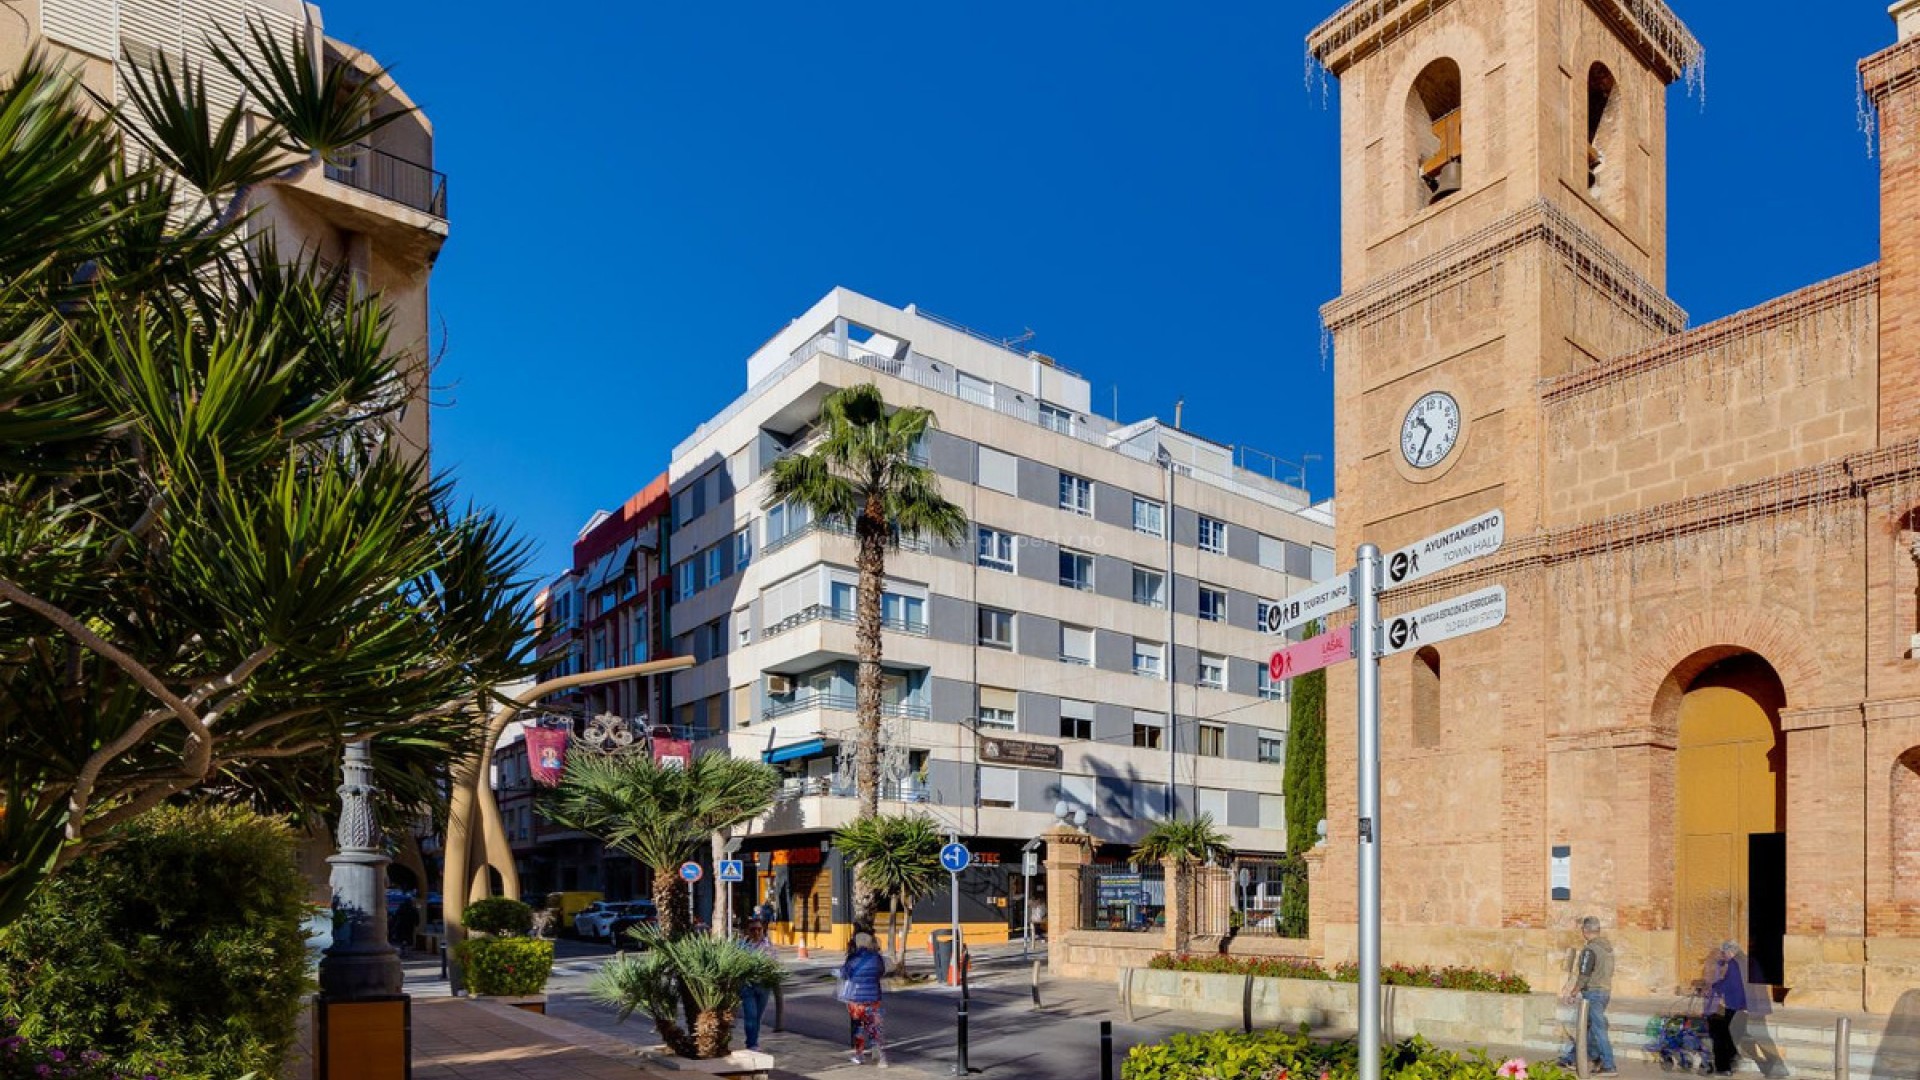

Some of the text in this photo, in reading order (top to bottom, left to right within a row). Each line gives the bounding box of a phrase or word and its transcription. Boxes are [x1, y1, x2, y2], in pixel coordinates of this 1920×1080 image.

[1424, 515, 1499, 554] AYUNTAMIENTO
[1444, 534, 1499, 561] TOWN HALL
[1303, 585, 1347, 611] TOURIST INFO
